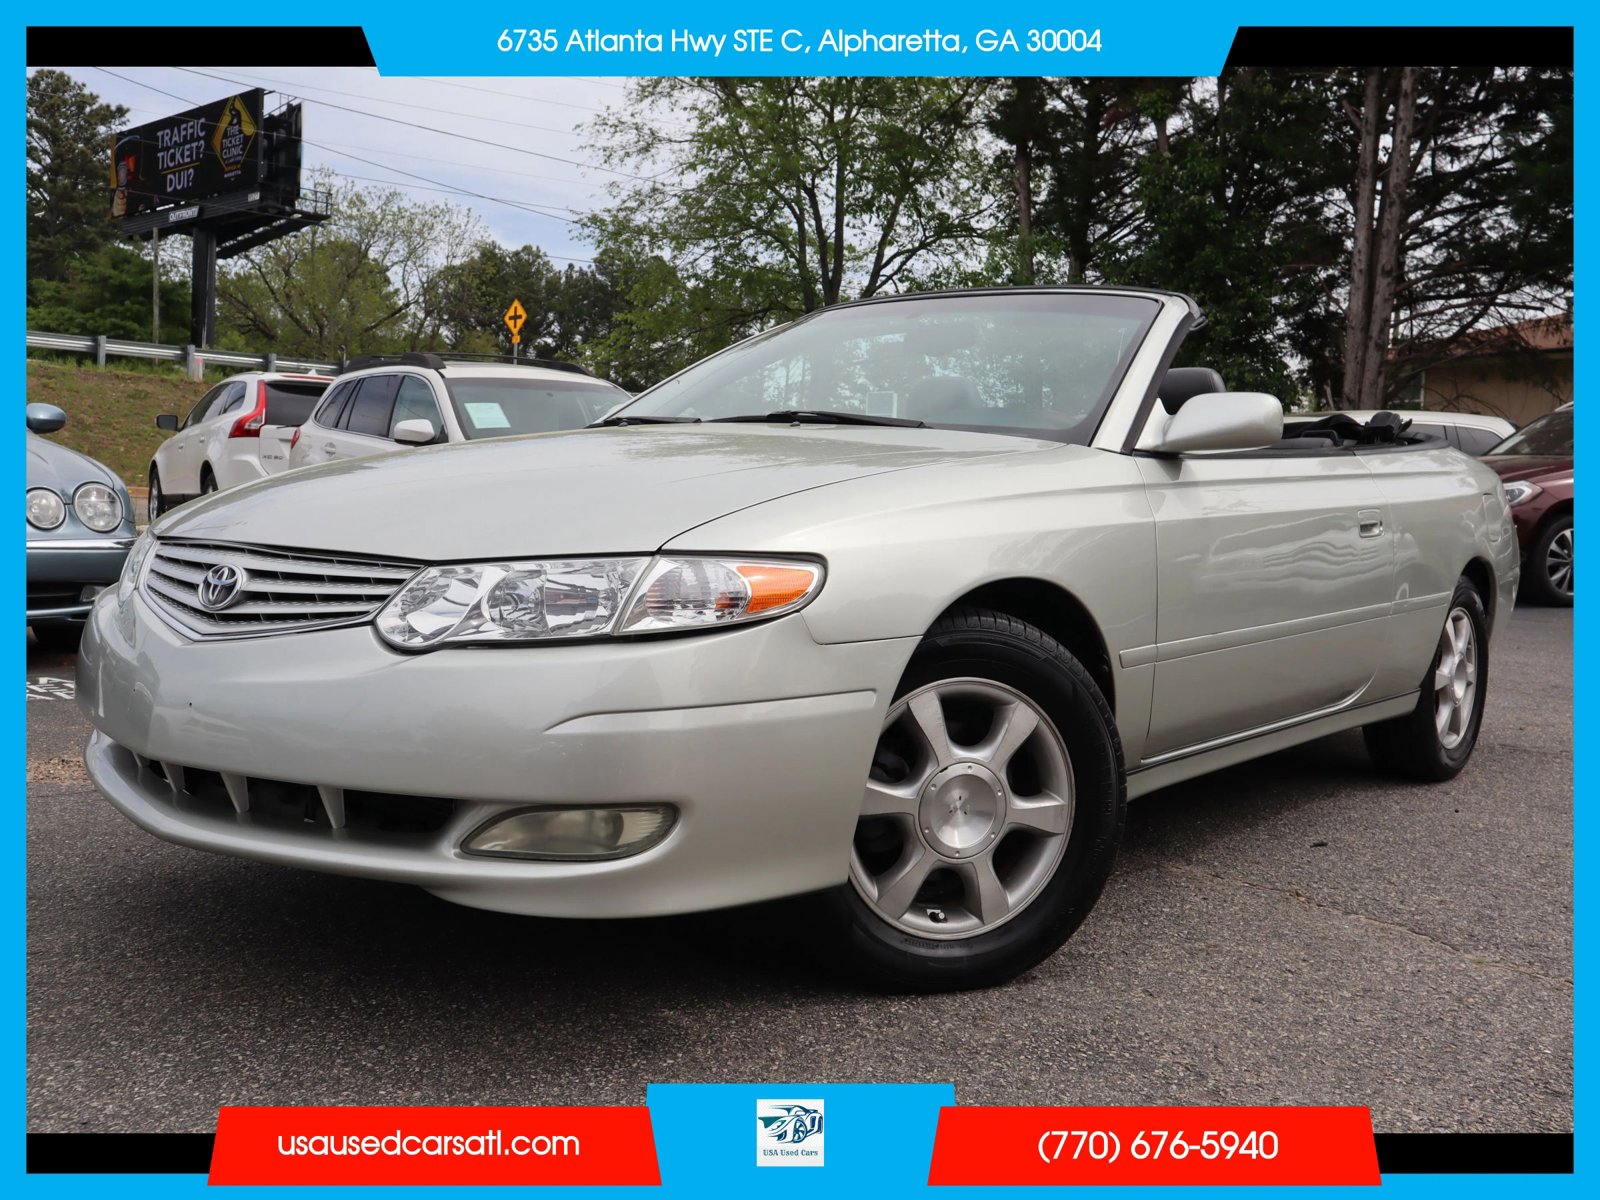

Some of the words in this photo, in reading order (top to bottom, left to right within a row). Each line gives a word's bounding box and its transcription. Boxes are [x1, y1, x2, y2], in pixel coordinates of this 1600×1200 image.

[157, 118, 206, 149] TRAFFIC
[227, 126, 240, 136] THE
[222, 134, 243, 148] TICKET
[157, 140, 205, 169] TICKET?
[222, 145, 243, 159] CLINIC
[167, 169, 194, 192] DUI?
